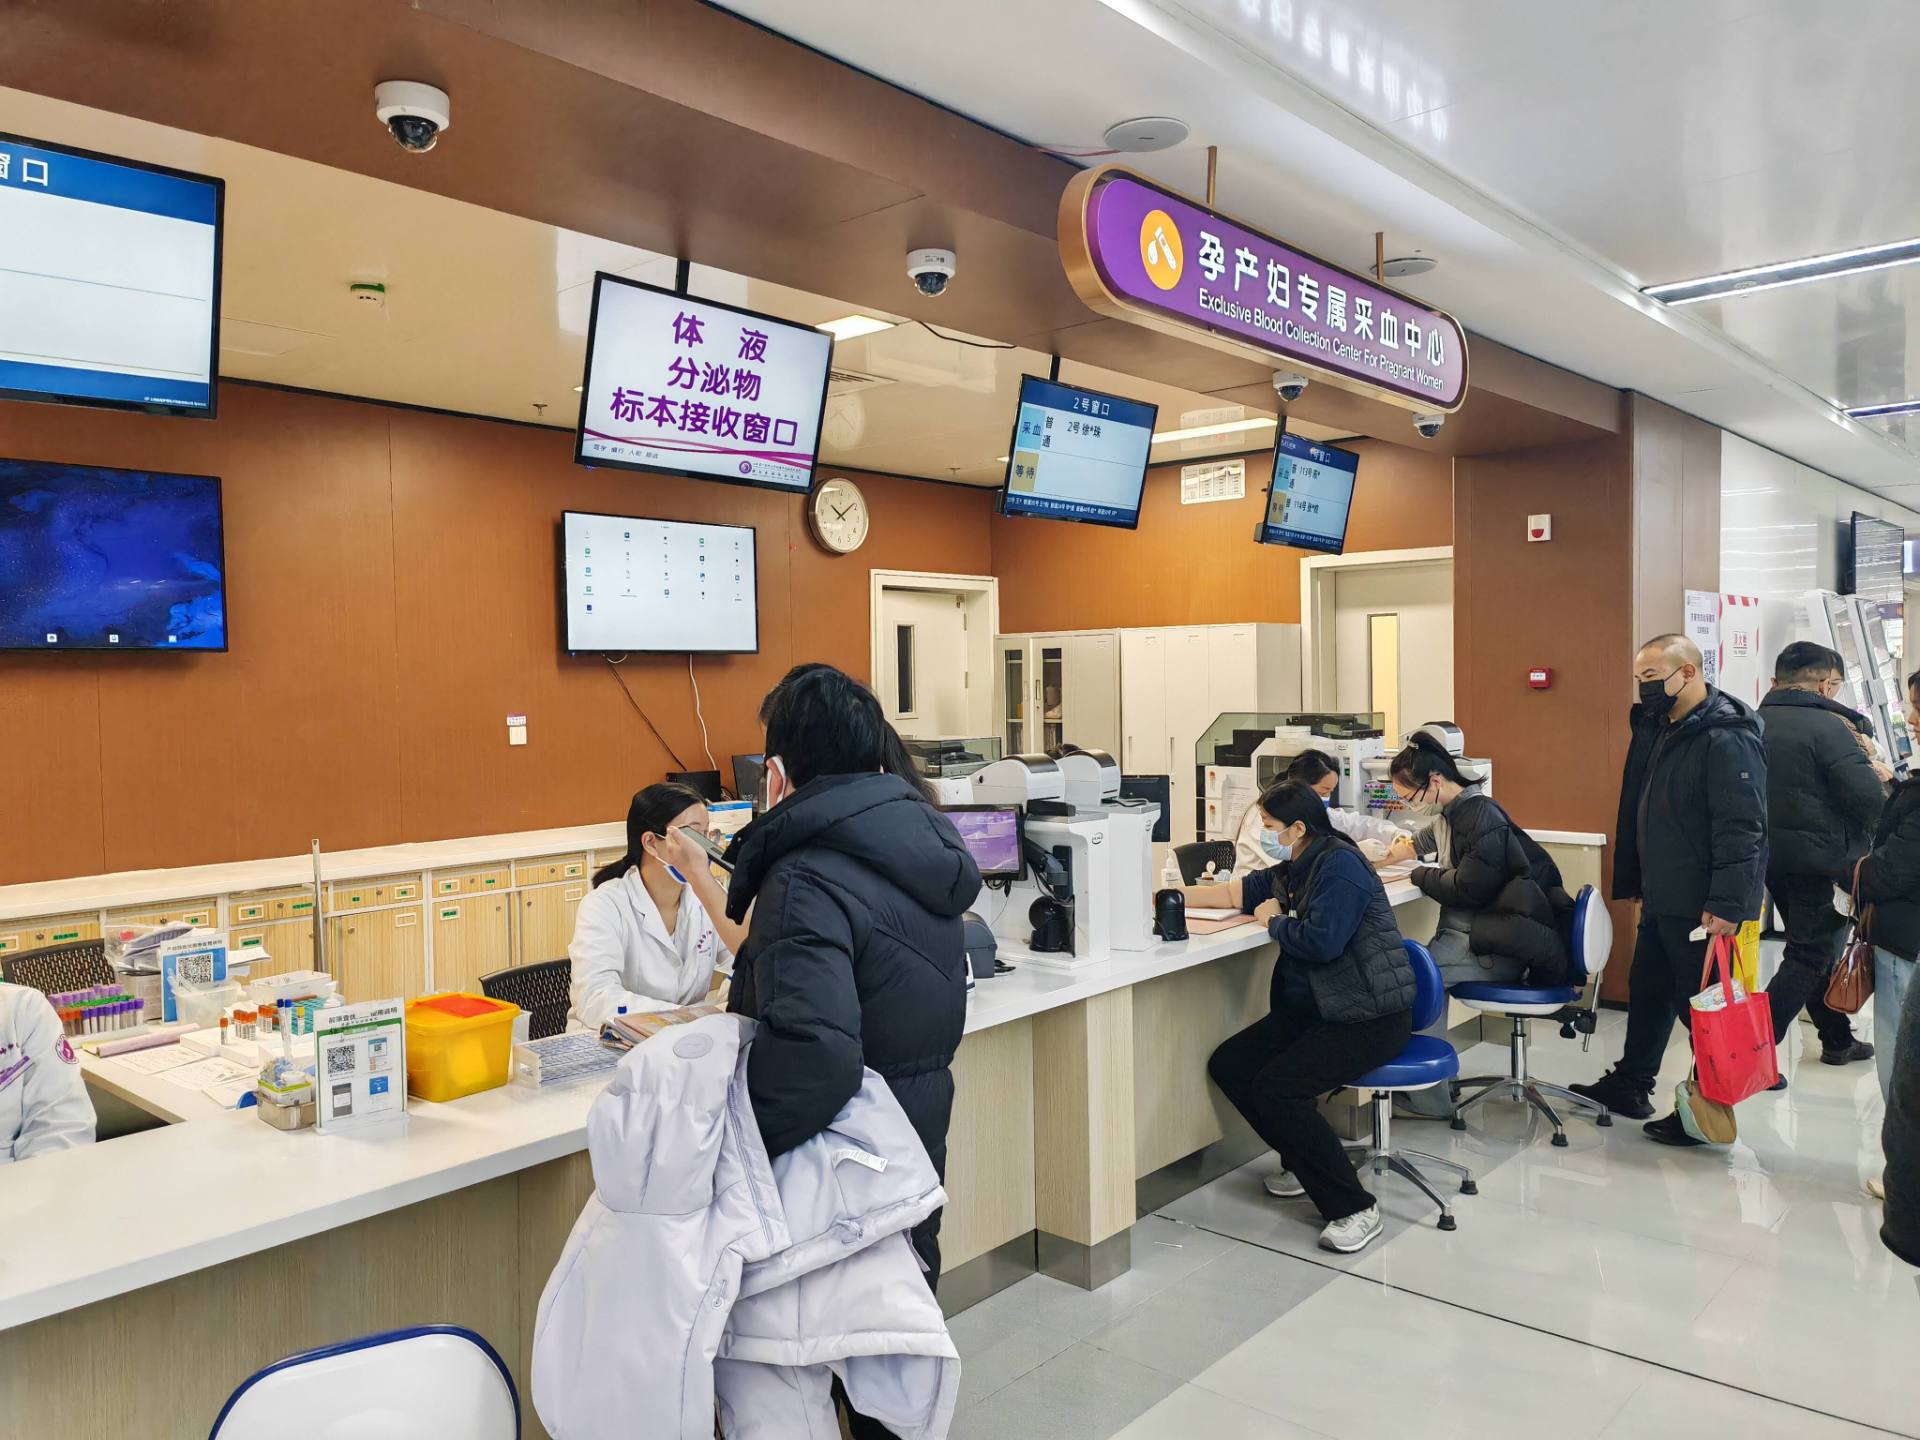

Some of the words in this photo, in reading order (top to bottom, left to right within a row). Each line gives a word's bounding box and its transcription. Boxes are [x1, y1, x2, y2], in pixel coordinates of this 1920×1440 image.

[1199, 231, 1444, 367] 孕产妇专属采血中心
[672, 312, 705, 348] 体
[738, 327, 768, 363] 液
[1199, 288, 1251, 324] Exclusive
[1254, 309, 1283, 334] Blood
[1285, 322, 1331, 351] Collection
[1333, 339, 1362, 362] Center
[1364, 350, 1378, 367] For
[1379, 355, 1415, 380] Pregnant
[1416, 368, 1444, 391] Women
[667, 356, 761, 402] 分泌物
[1074, 398, 1110, 415] 2号窗口
[610, 387, 798, 446] 标本接收窗口
